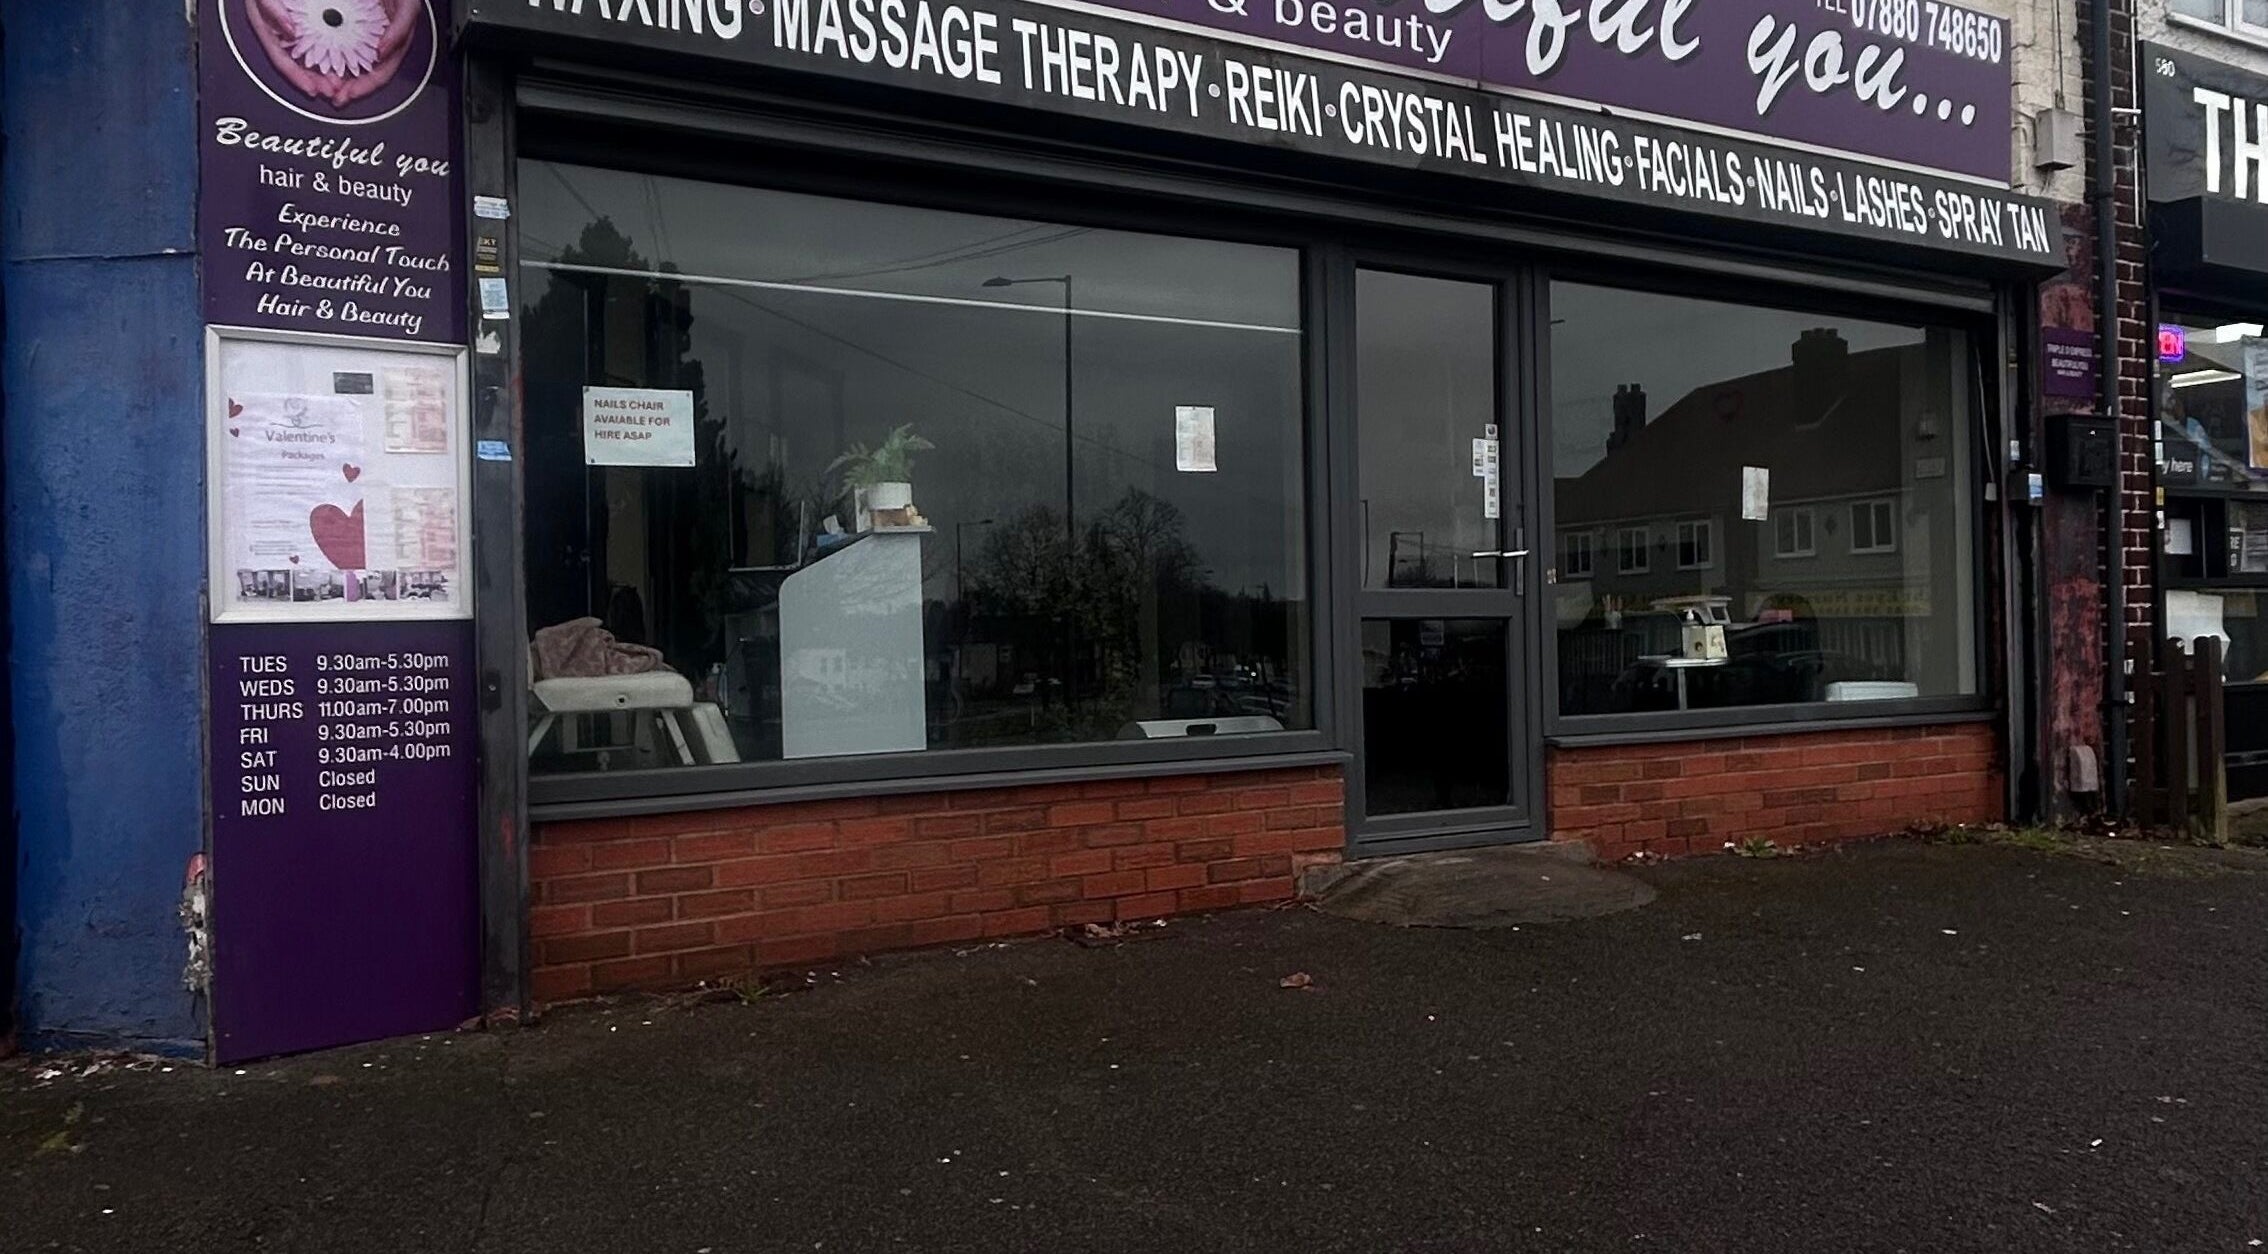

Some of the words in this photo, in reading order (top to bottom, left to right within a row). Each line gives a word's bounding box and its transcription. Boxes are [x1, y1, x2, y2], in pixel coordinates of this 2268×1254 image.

[1275, 0, 1452, 62] beauty
[1851, 0, 1920, 42] 07880
[1926, 1, 2002, 64] 748650
[773, 0, 1001, 84] MASSAGE
[1013, 20, 1202, 118] THERAPY
[1225, 59, 1323, 137] REIKI
[1339, 81, 1488, 165] CRYSTAL
[1493, 110, 1624, 186] HEALING
[1634, 135, 1746, 207] FACIALS
[1754, 157, 1828, 220] NAILS
[1837, 171, 1929, 235] LASHES
[1935, 189, 2002, 246] SPRAY
[2007, 203, 2050, 253] TAN
[215, 117, 385, 169] Beautiful
[396, 152, 450, 177] you
[260, 164, 304, 189] hair
[313, 172, 330, 193] &
[339, 175, 412, 207] beauty
[279, 203, 401, 236] Experience
[224, 227, 267, 252] The
[274, 234, 380, 264] Personal
[385, 246, 450, 272] Touch
[245, 261, 276, 283] At
[281, 265, 388, 294] Beautiful
[393, 277, 431, 299] You
[257, 293, 313, 317] Hair
[315, 299, 334, 320] &
[341, 301, 423, 335] Beauty
[594, 399, 627, 409] NAILS
[629, 400, 664, 410] CHAIR
[594, 414, 646, 426] AVAIABLE
[649, 416, 671, 426] FOR
[265, 430, 336, 444] Valentine's
[594, 430, 620, 440] HIRE
[624, 431, 652, 440] ASAP
[240, 656, 287, 673] TUES
[317, 653, 449, 672] 9.30am-5.30pm
[240, 678, 295, 697] WEDS
[317, 675, 450, 694] 9.30am-5.30pm
[241, 702, 304, 721] THURS
[318, 698, 450, 718] 11.00am-7.00pm
[240, 728, 268, 745] FRI
[318, 721, 450, 741] 9.30am-5.30pm
[240, 750, 277, 769] SAT
[318, 744, 451, 764] 9.30am-4.00pm
[241, 774, 280, 793] SUN
[319, 769, 376, 787] Closed
[241, 798, 285, 817] MON
[319, 791, 376, 811] Closed
